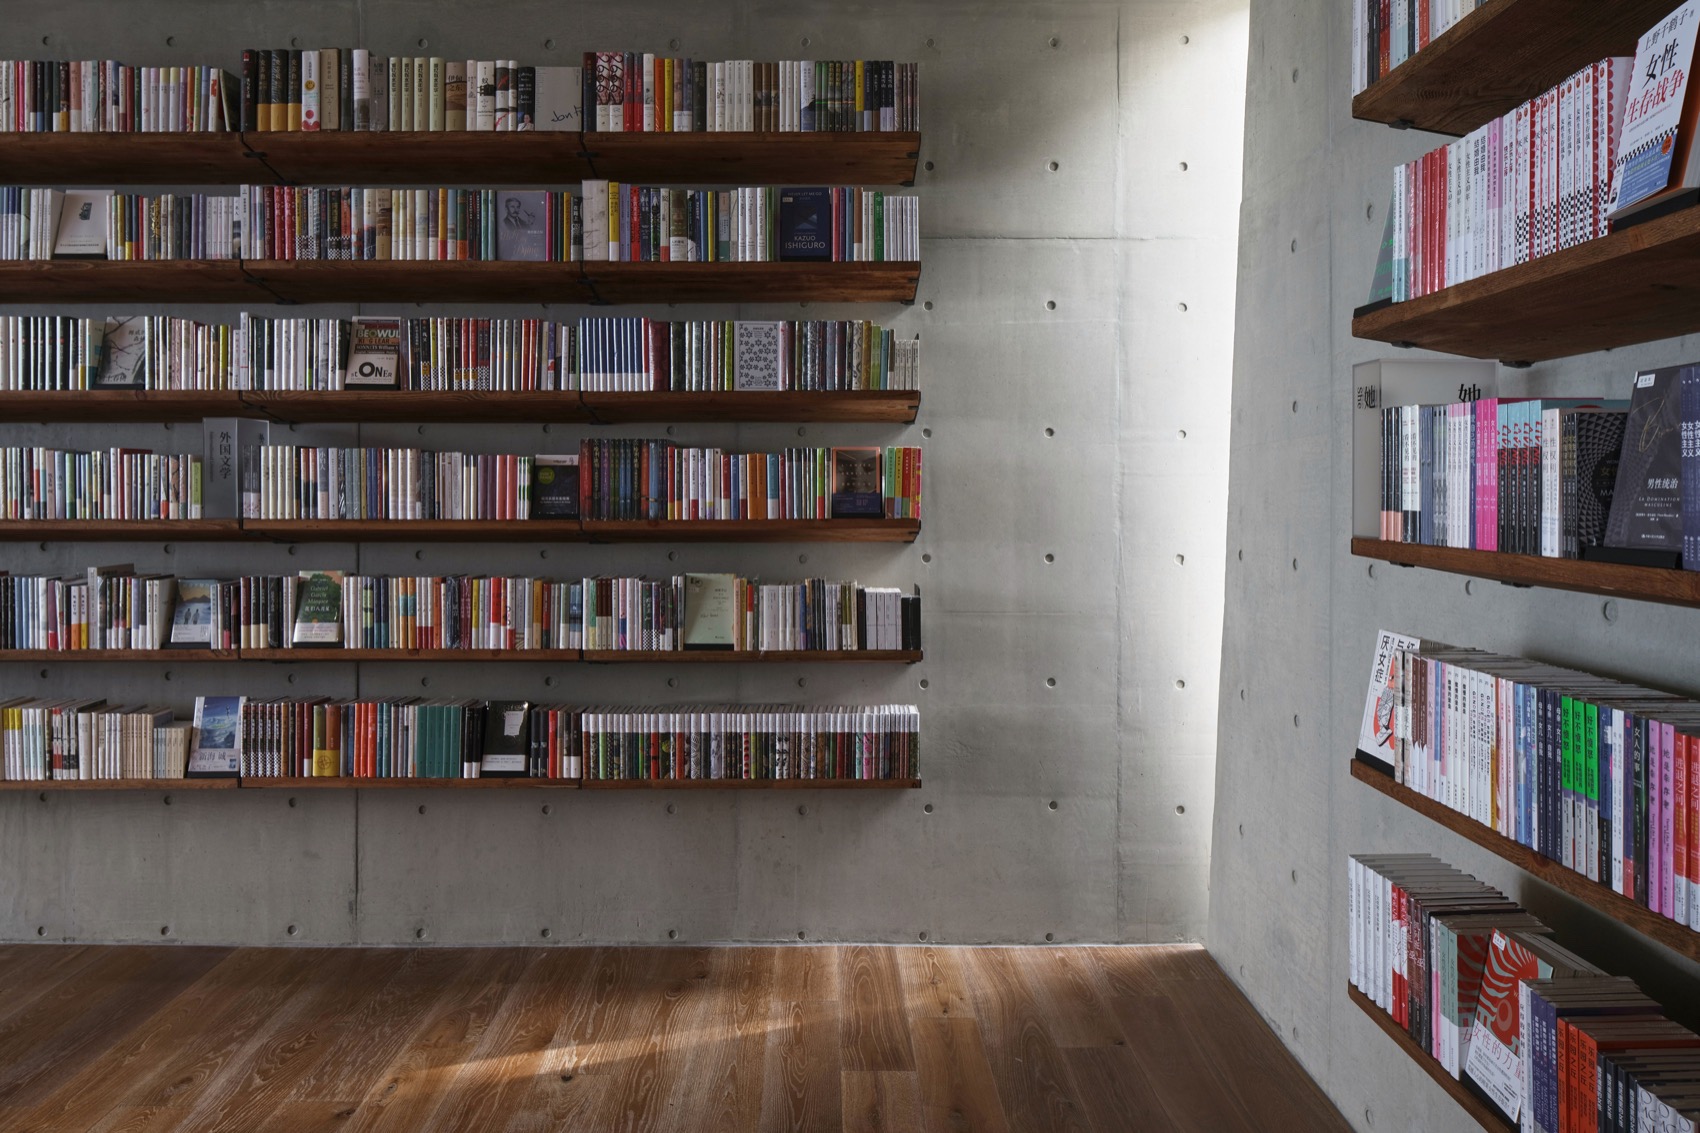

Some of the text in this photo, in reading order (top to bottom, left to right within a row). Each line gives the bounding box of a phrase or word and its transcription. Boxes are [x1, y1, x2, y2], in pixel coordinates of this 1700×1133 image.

[1642, 38, 1679, 90] 女性
[1627, 69, 1685, 125] 生存战争
[785, 241, 826, 249] ISHIGURO
[1364, 385, 1376, 409] 她
[1458, 384, 1481, 403] 她
[219, 431, 231, 480] 外国文学
[1646, 477, 1678, 489] 男性统治
[1633, 726, 1641, 773] 女人的事
